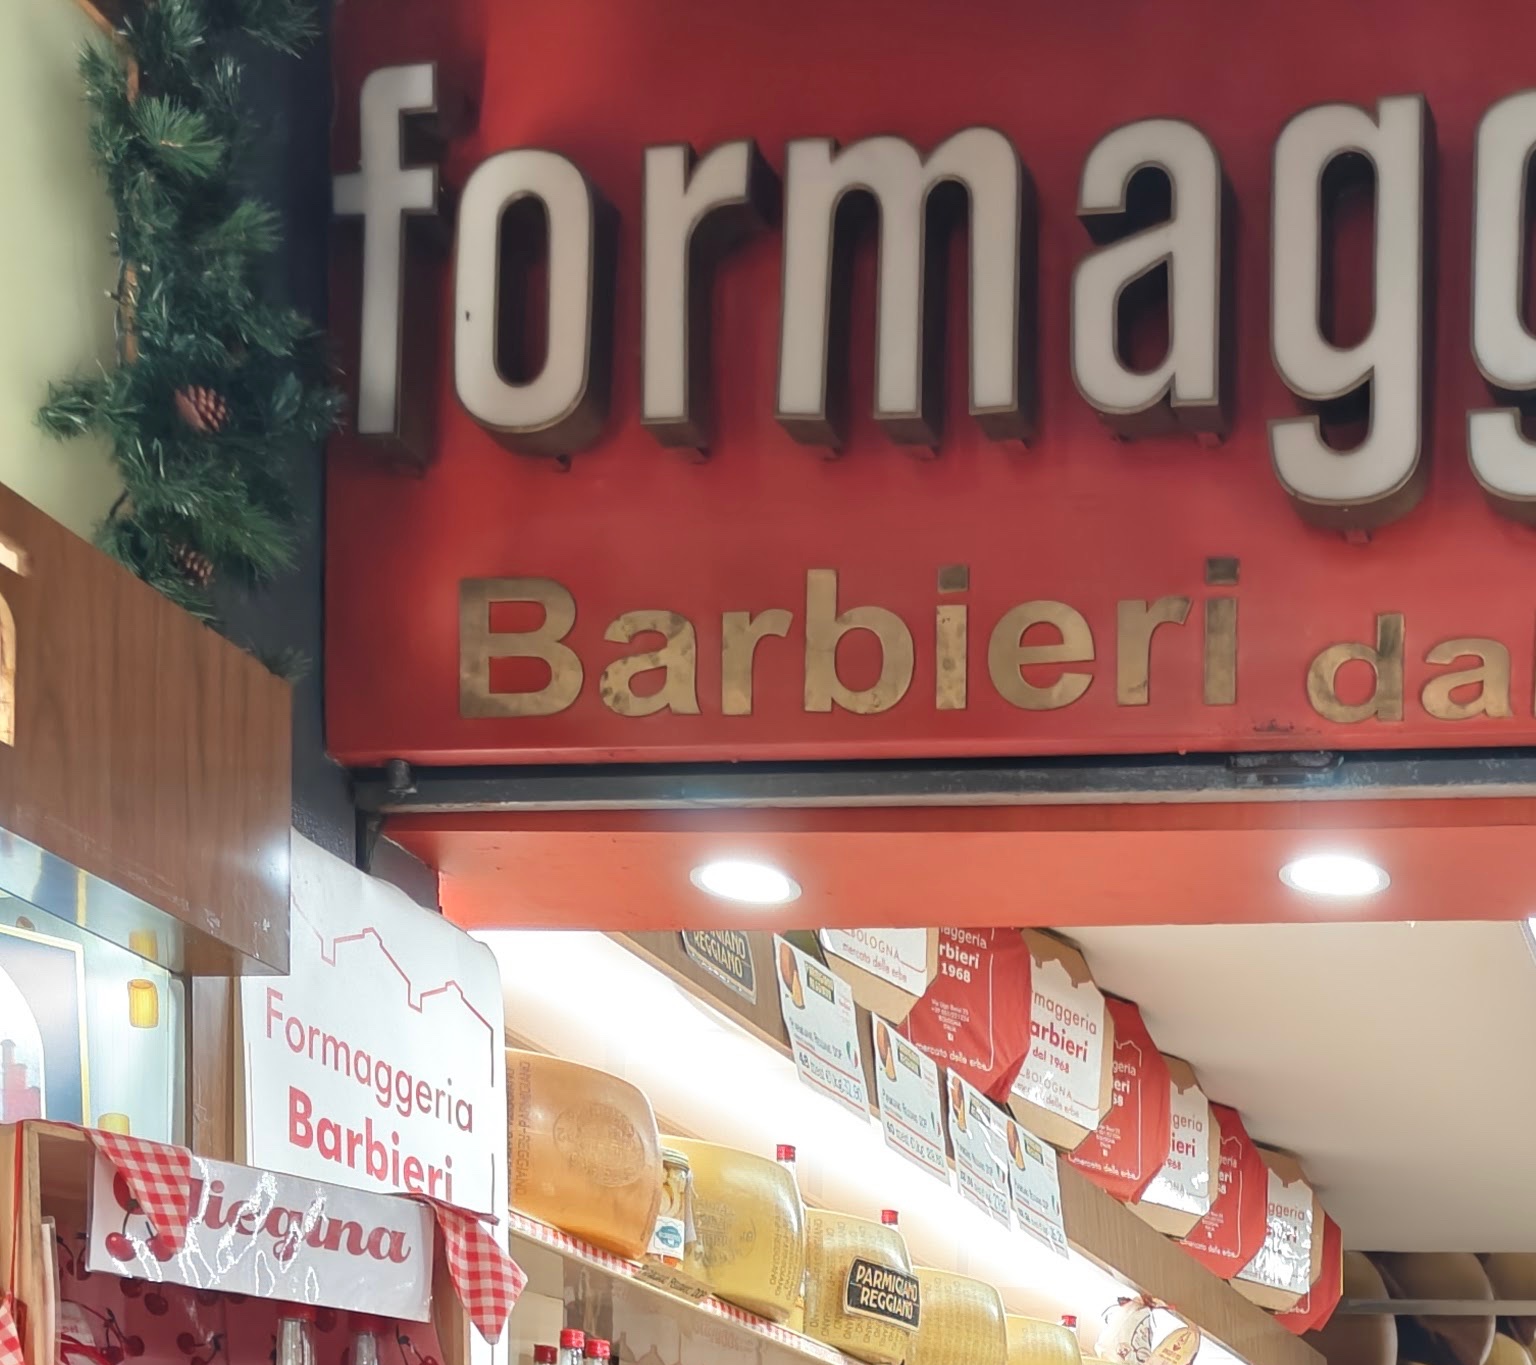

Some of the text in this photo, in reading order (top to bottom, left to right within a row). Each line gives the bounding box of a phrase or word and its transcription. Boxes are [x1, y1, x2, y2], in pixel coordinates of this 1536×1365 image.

[459, 556, 1241, 720] Barbieri
[849, 928, 900, 960] BOLOGNA
[938, 941, 981, 969] rbieri
[941, 961, 972, 984] 1968
[1032, 989, 1098, 1036] maggeria
[266, 986, 474, 1134] Formaggeria
[1030, 1021, 1089, 1063] arbieri
[1032, 1046, 1047, 1062] dal
[288, 1085, 454, 1197] Barbieri
[189, 1178, 411, 1264] liegina
[855, 1258, 918, 1303] PARMIGIANO
[859, 1288, 915, 1319] REGGIANO
